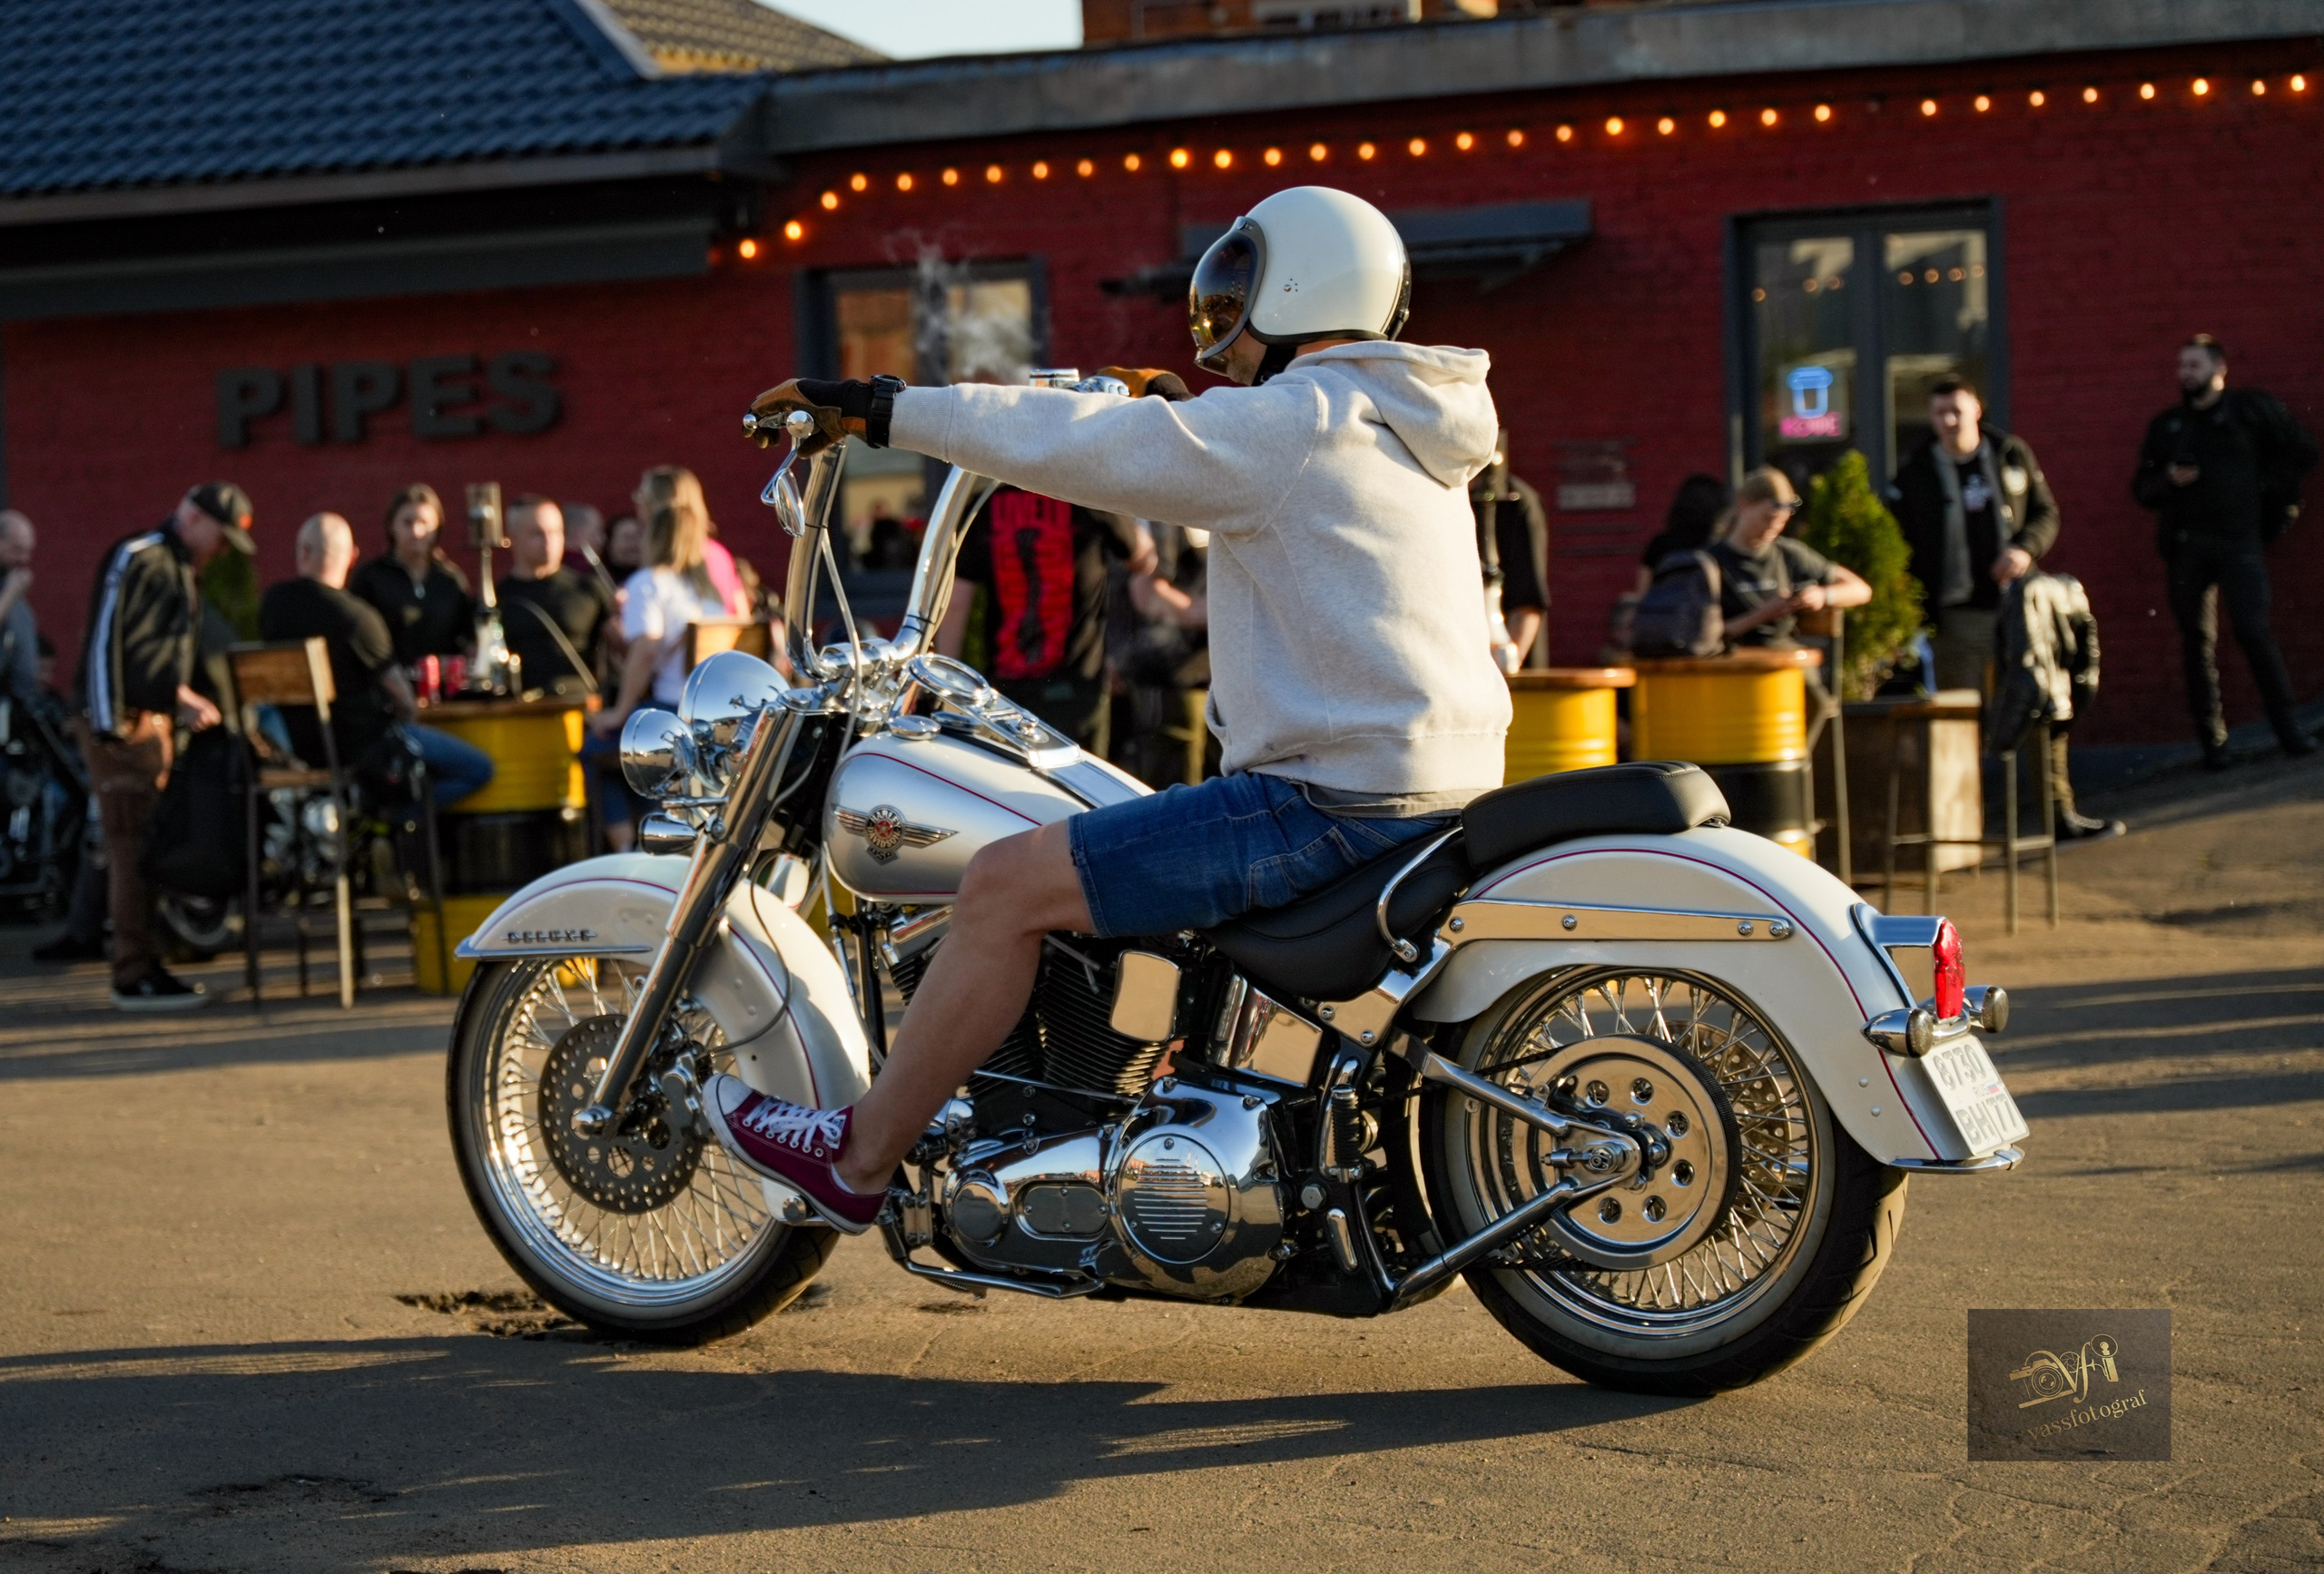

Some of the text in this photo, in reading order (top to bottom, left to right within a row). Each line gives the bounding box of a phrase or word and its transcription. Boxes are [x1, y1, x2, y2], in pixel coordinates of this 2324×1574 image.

[215, 350, 564, 450] PIPES
[870, 810, 901, 827] HARLEY
[867, 827, 901, 848] DAVIDSON
[870, 848, 892, 861] USA
[507, 930, 591, 944] DELUXE
